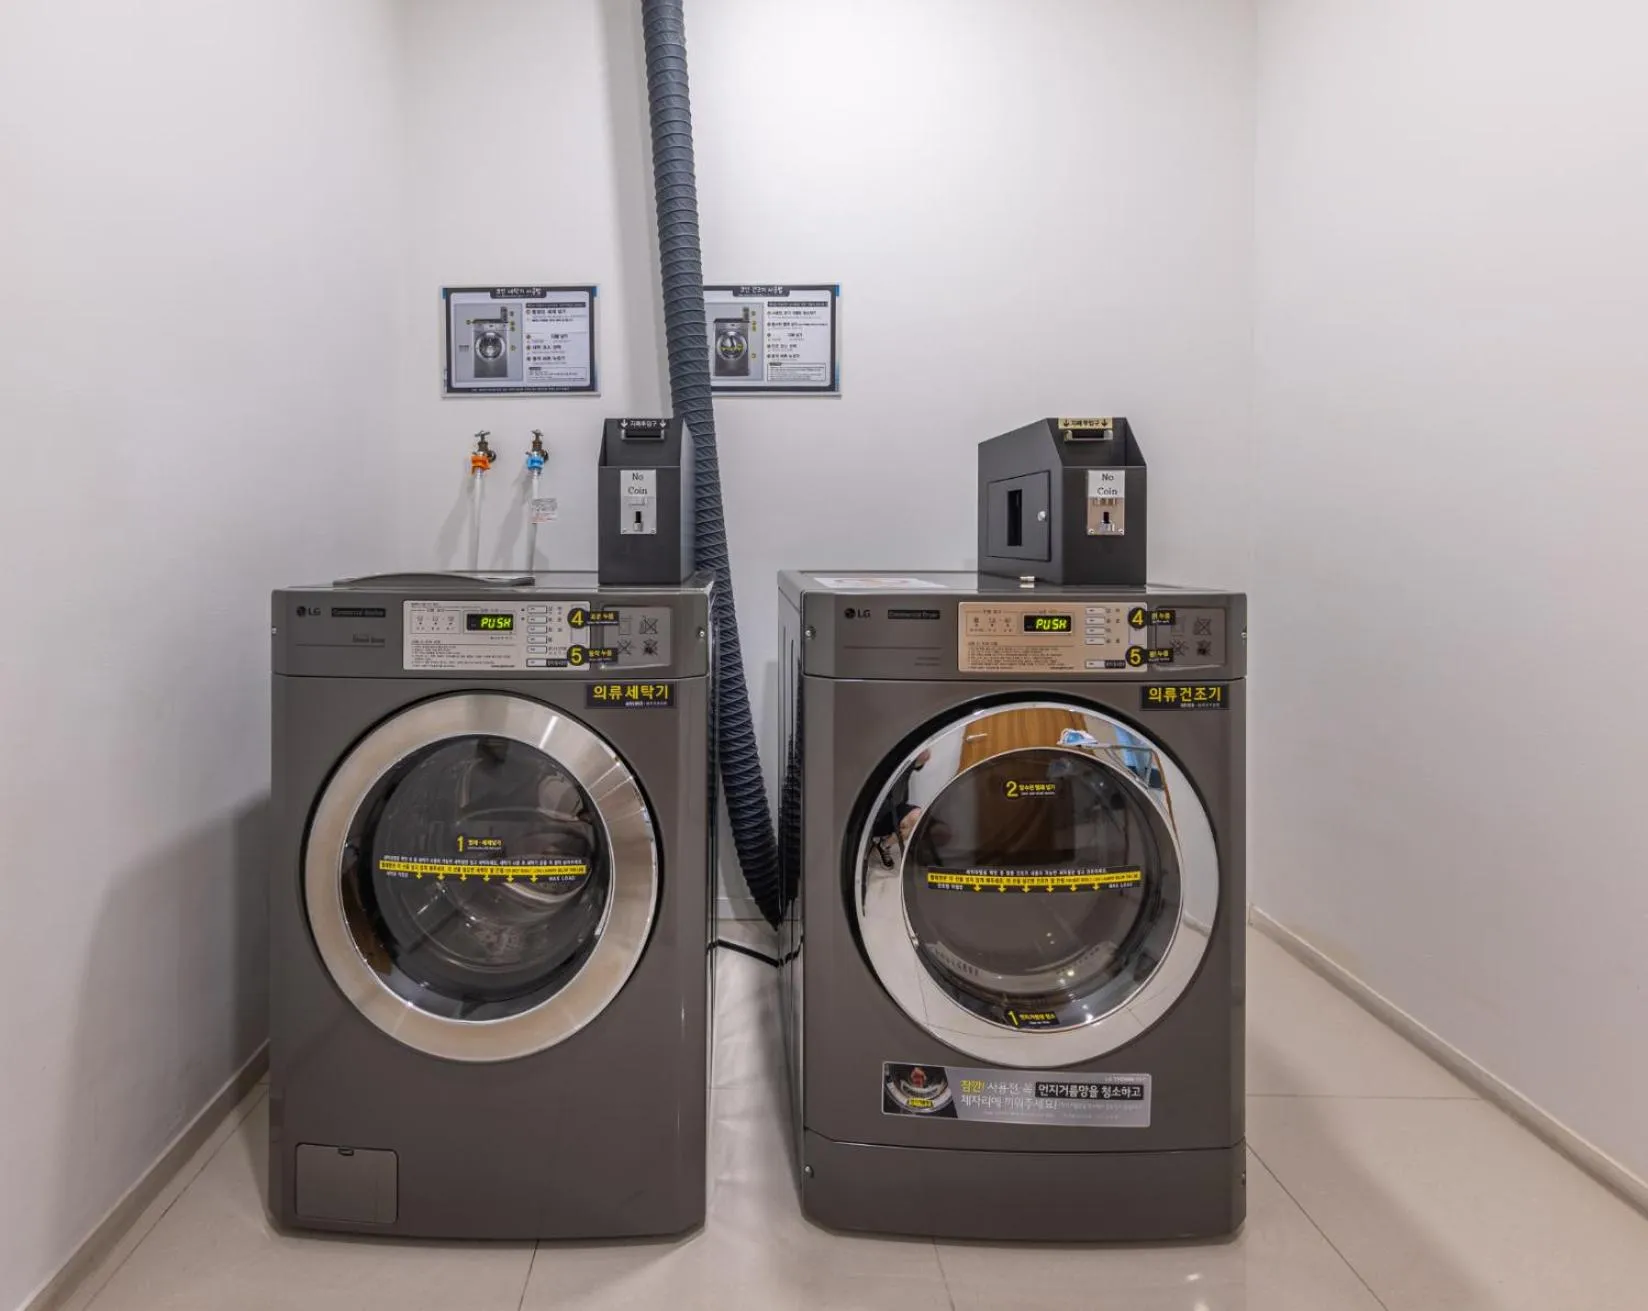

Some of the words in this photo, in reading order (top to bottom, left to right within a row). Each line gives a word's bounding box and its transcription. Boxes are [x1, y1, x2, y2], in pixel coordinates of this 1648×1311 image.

[632, 473, 644, 481] No
[1101, 473, 1114, 481] No
[628, 486, 648, 495] Coin
[1097, 487, 1118, 496] Coin
[480, 616, 512, 629] PUSH
[571, 610, 583, 626] 4
[1035, 618, 1067, 631] PUSH
[1131, 609, 1144, 625] 4
[571, 647, 583, 664] 5
[1130, 648, 1141, 665] 5
[593, 684, 623, 700] 의류
[624, 684, 669, 700] 세탁기
[1148, 686, 1178, 703] 의류
[1179, 686, 1222, 702] 건조기
[1006, 780, 1019, 798] 2
[457, 835, 464, 852] 1
[1008, 1010, 1019, 1026] 1
[1038, 1083, 1099, 1099] 먼지거름망을
[1101, 1085, 1142, 1100] 청소하고
[961, 1095, 1002, 1109] 제자리에
